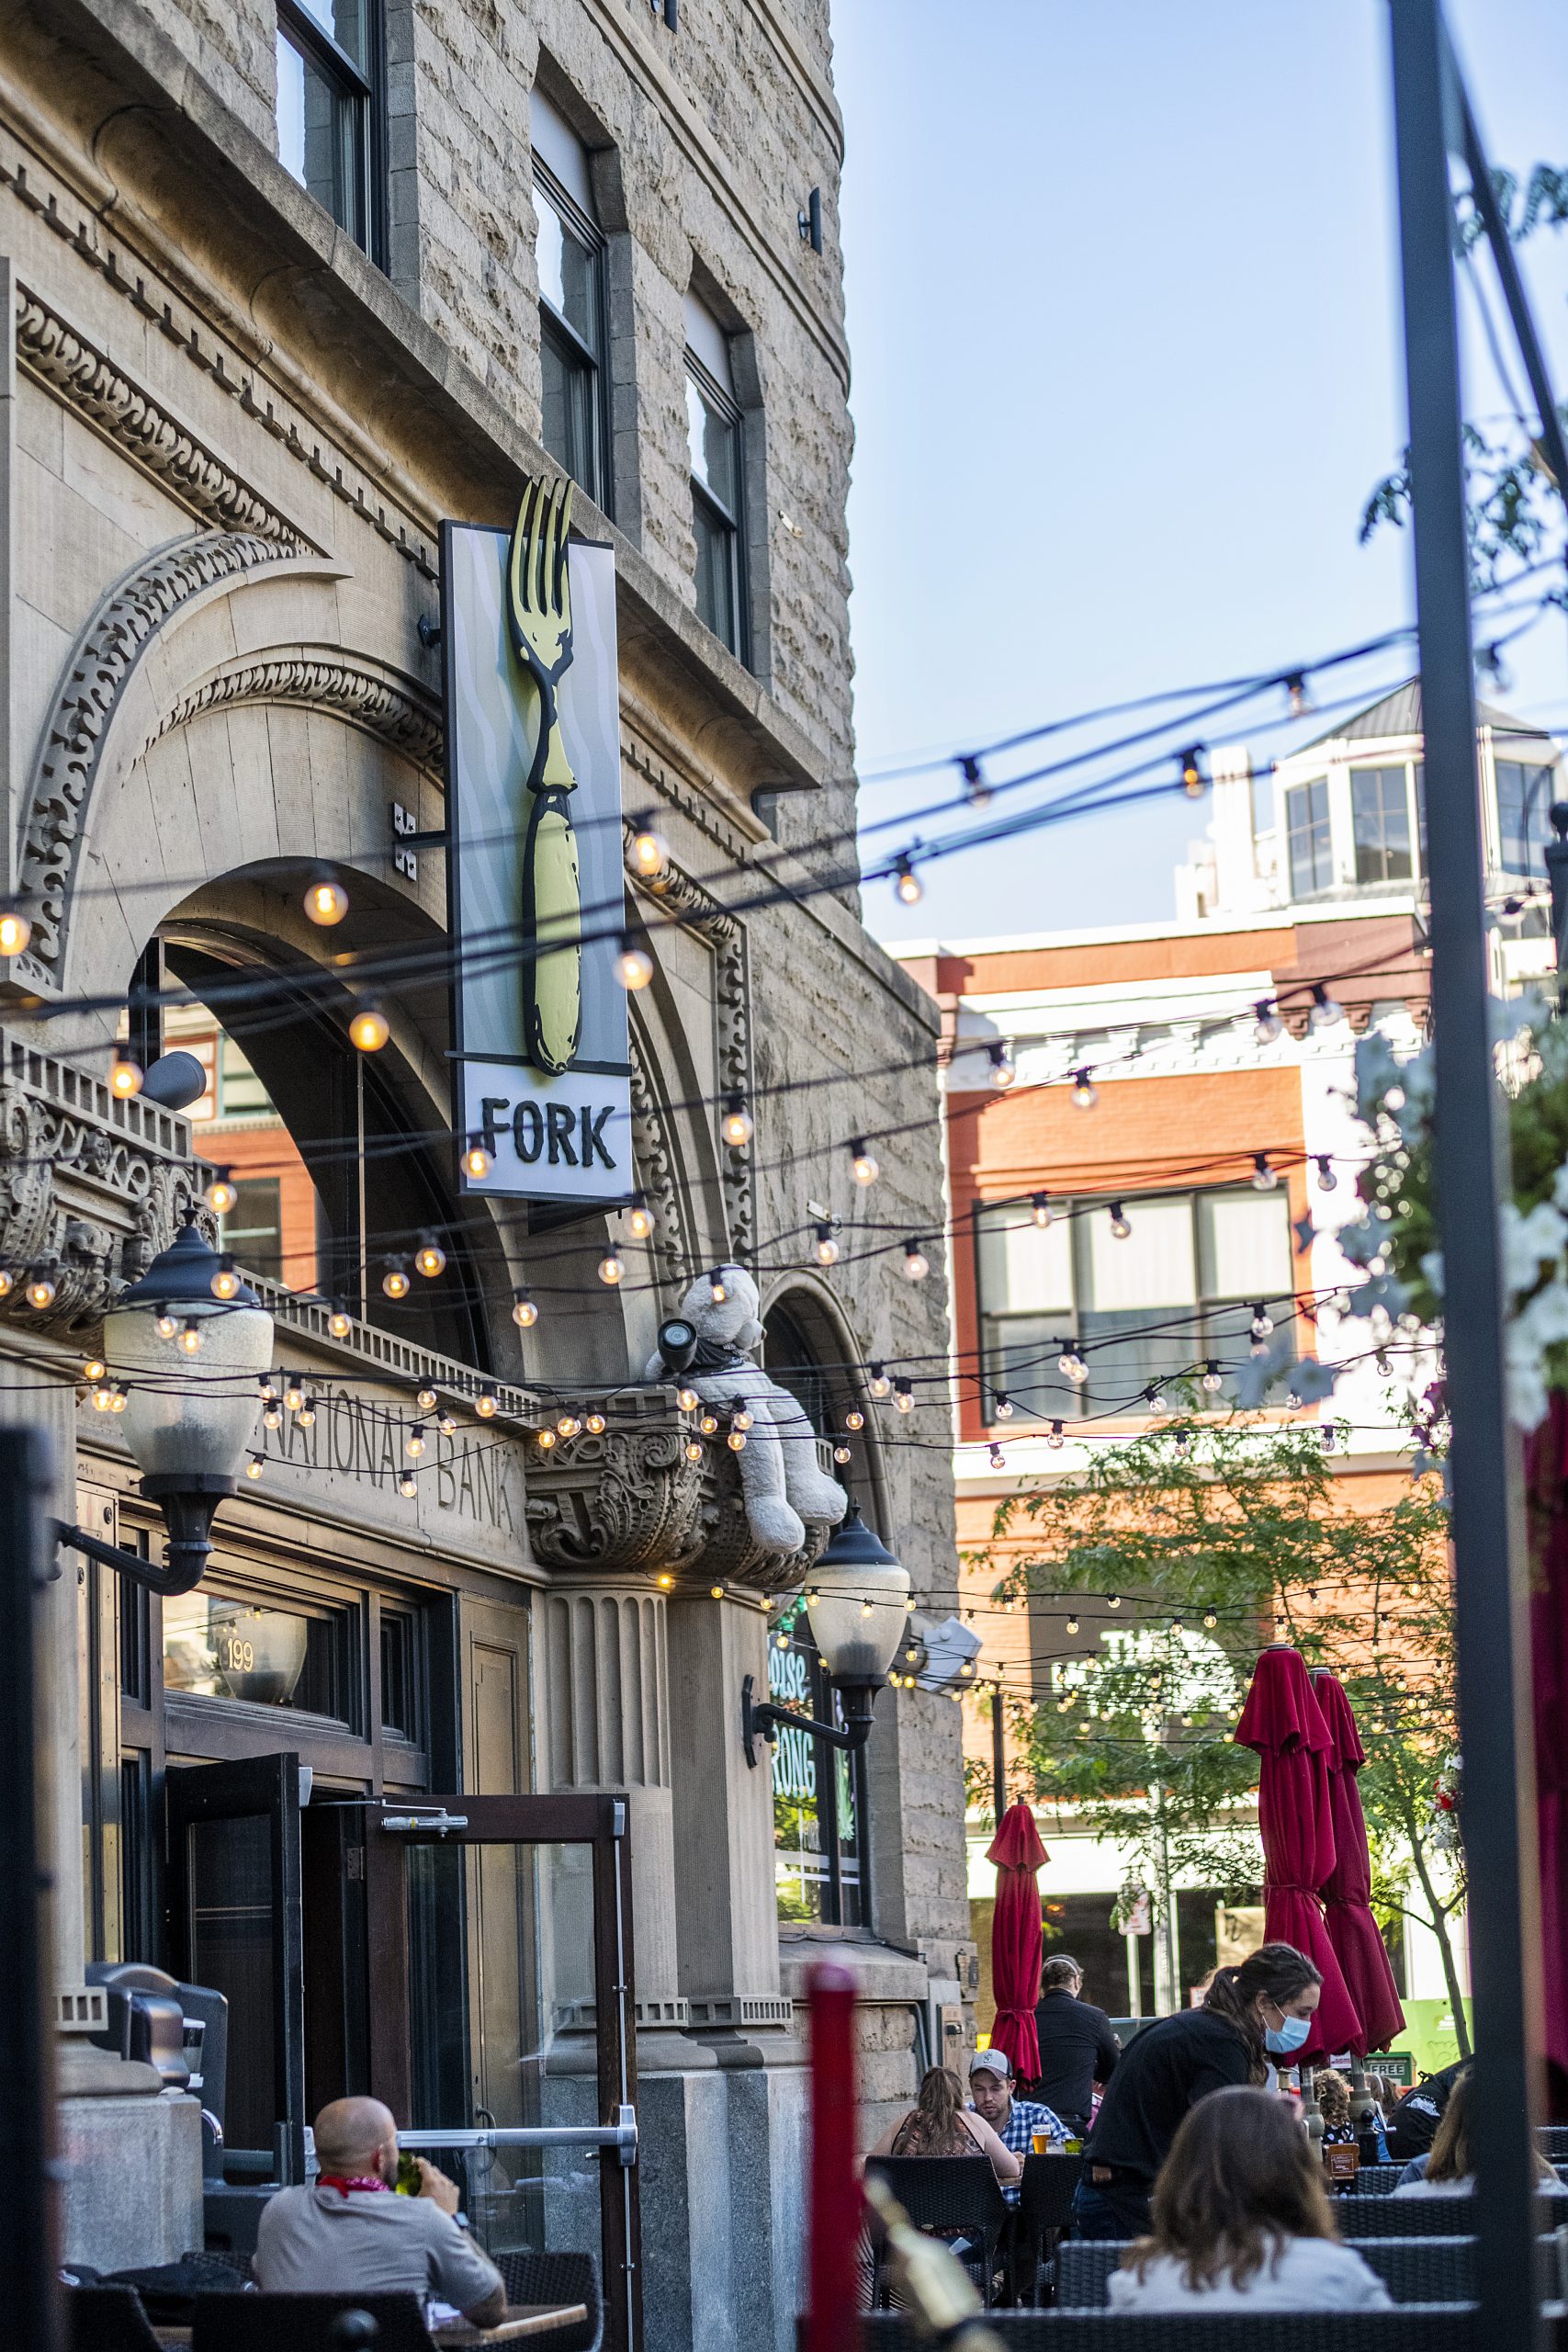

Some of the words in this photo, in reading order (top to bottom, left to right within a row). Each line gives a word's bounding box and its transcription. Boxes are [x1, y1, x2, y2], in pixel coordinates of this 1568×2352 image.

[481, 1097, 616, 1169] FORK
[263, 1374, 416, 1498] NATIONAL
[436, 1425, 515, 1532] BANK
[228, 1637, 254, 1672] 199
[768, 1646, 807, 1702] oise
[772, 1724, 817, 1798] RONG
[1371, 2064, 1404, 2075] FREE
